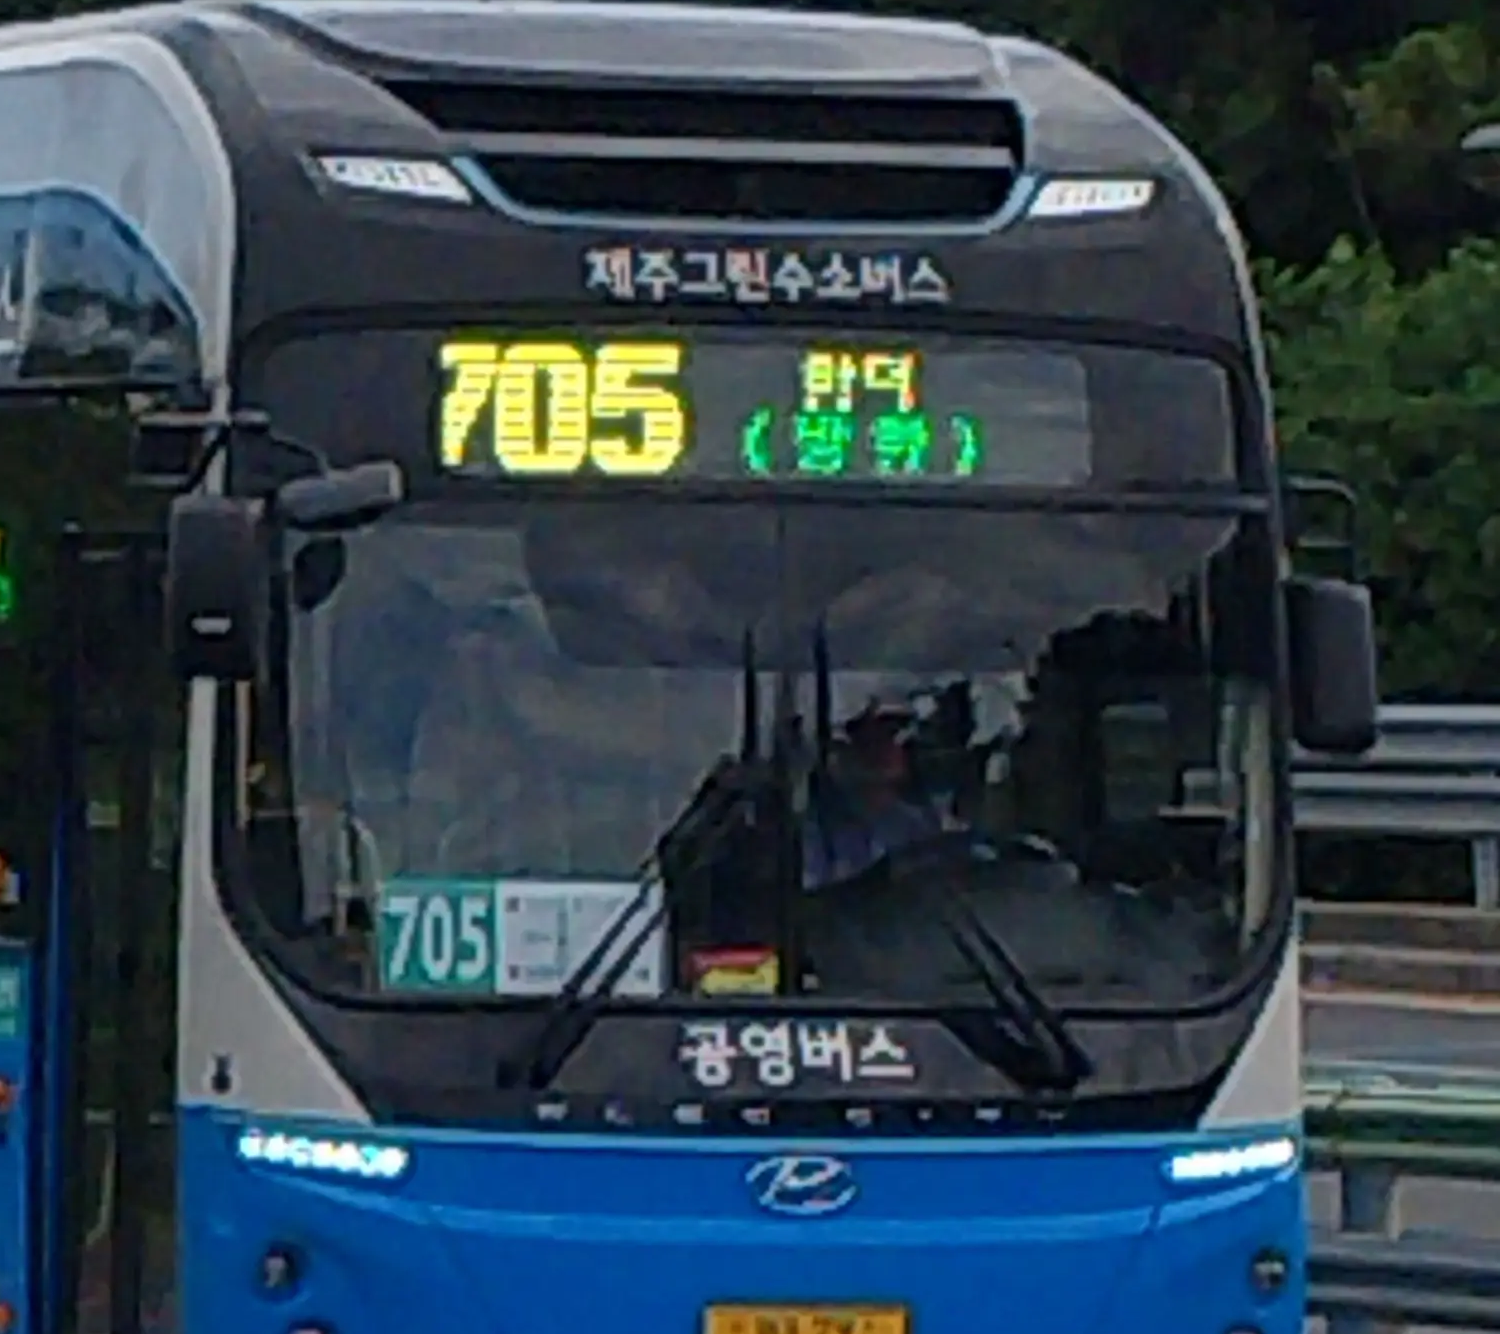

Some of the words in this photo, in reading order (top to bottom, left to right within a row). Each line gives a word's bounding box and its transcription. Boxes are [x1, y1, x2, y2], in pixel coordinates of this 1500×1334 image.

[585, 247, 951, 304] 제주그린수소버스
[441, 343, 684, 475] 705
[383, 892, 489, 986] 705
[679, 1022, 914, 1086] 공영버스
